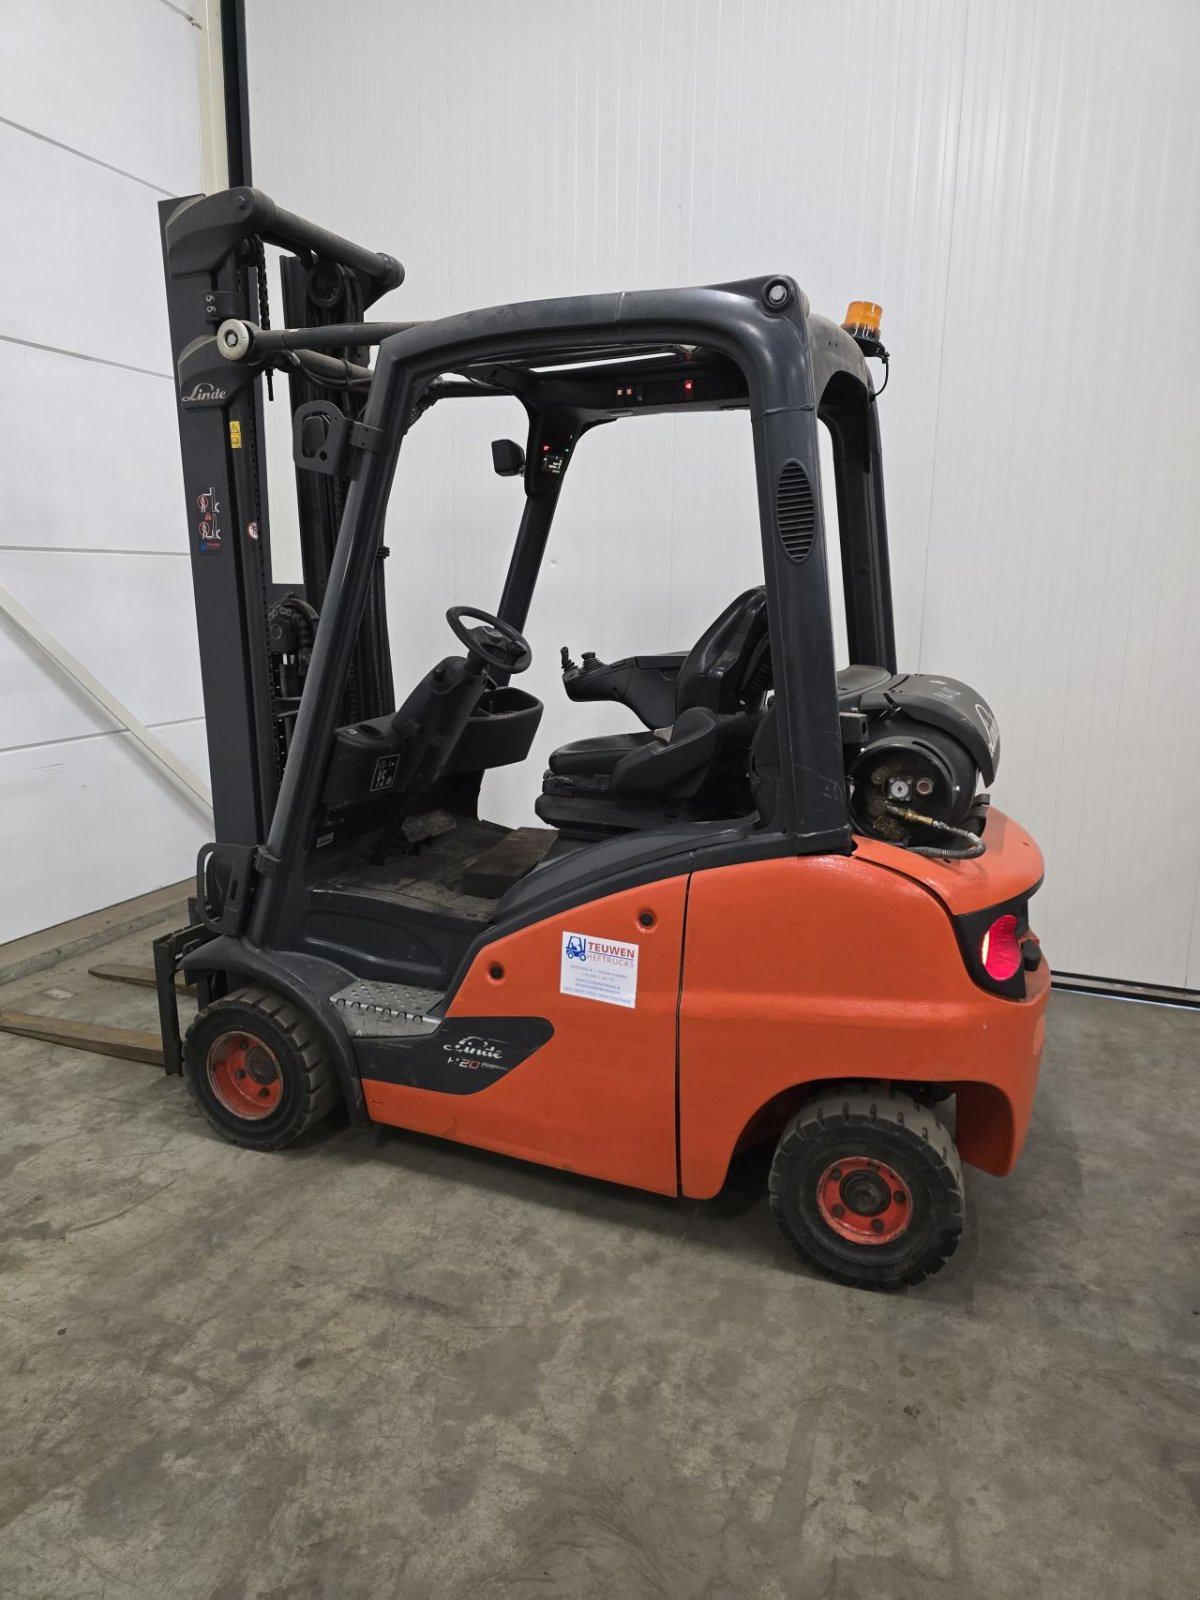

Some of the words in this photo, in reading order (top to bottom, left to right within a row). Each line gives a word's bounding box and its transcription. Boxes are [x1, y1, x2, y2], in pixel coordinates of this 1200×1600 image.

[181, 382, 226, 402] Linde
[588, 941, 635, 959] TEUWEN
[587, 953, 635, 968] HEFTRUCKS
